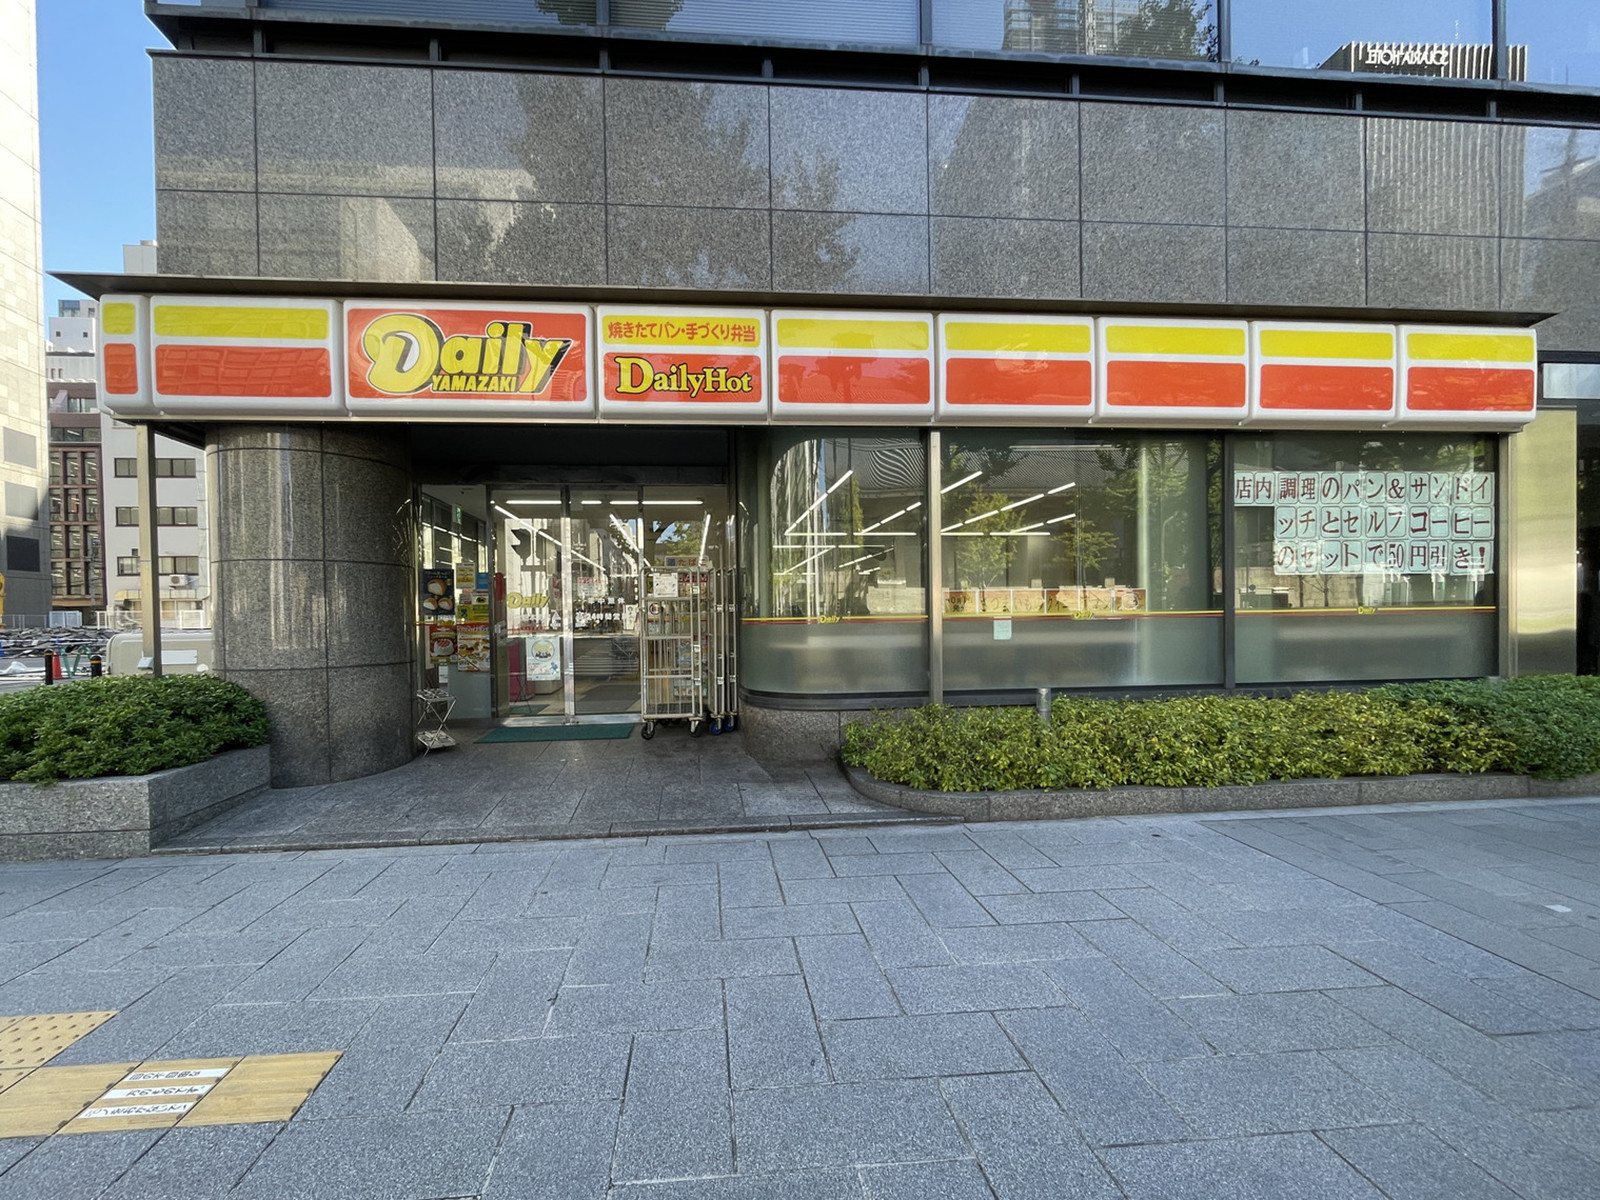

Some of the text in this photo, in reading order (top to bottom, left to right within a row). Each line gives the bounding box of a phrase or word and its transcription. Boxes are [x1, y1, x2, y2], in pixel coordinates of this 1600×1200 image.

[608, 321, 756, 342] 焼きたてパン・手づくり弁当
[363, 313, 571, 394] Daily
[432, 375, 517, 392] YAMAZAKI
[506, 592, 550, 609] Daily
[820, 615, 840, 624] Daily
